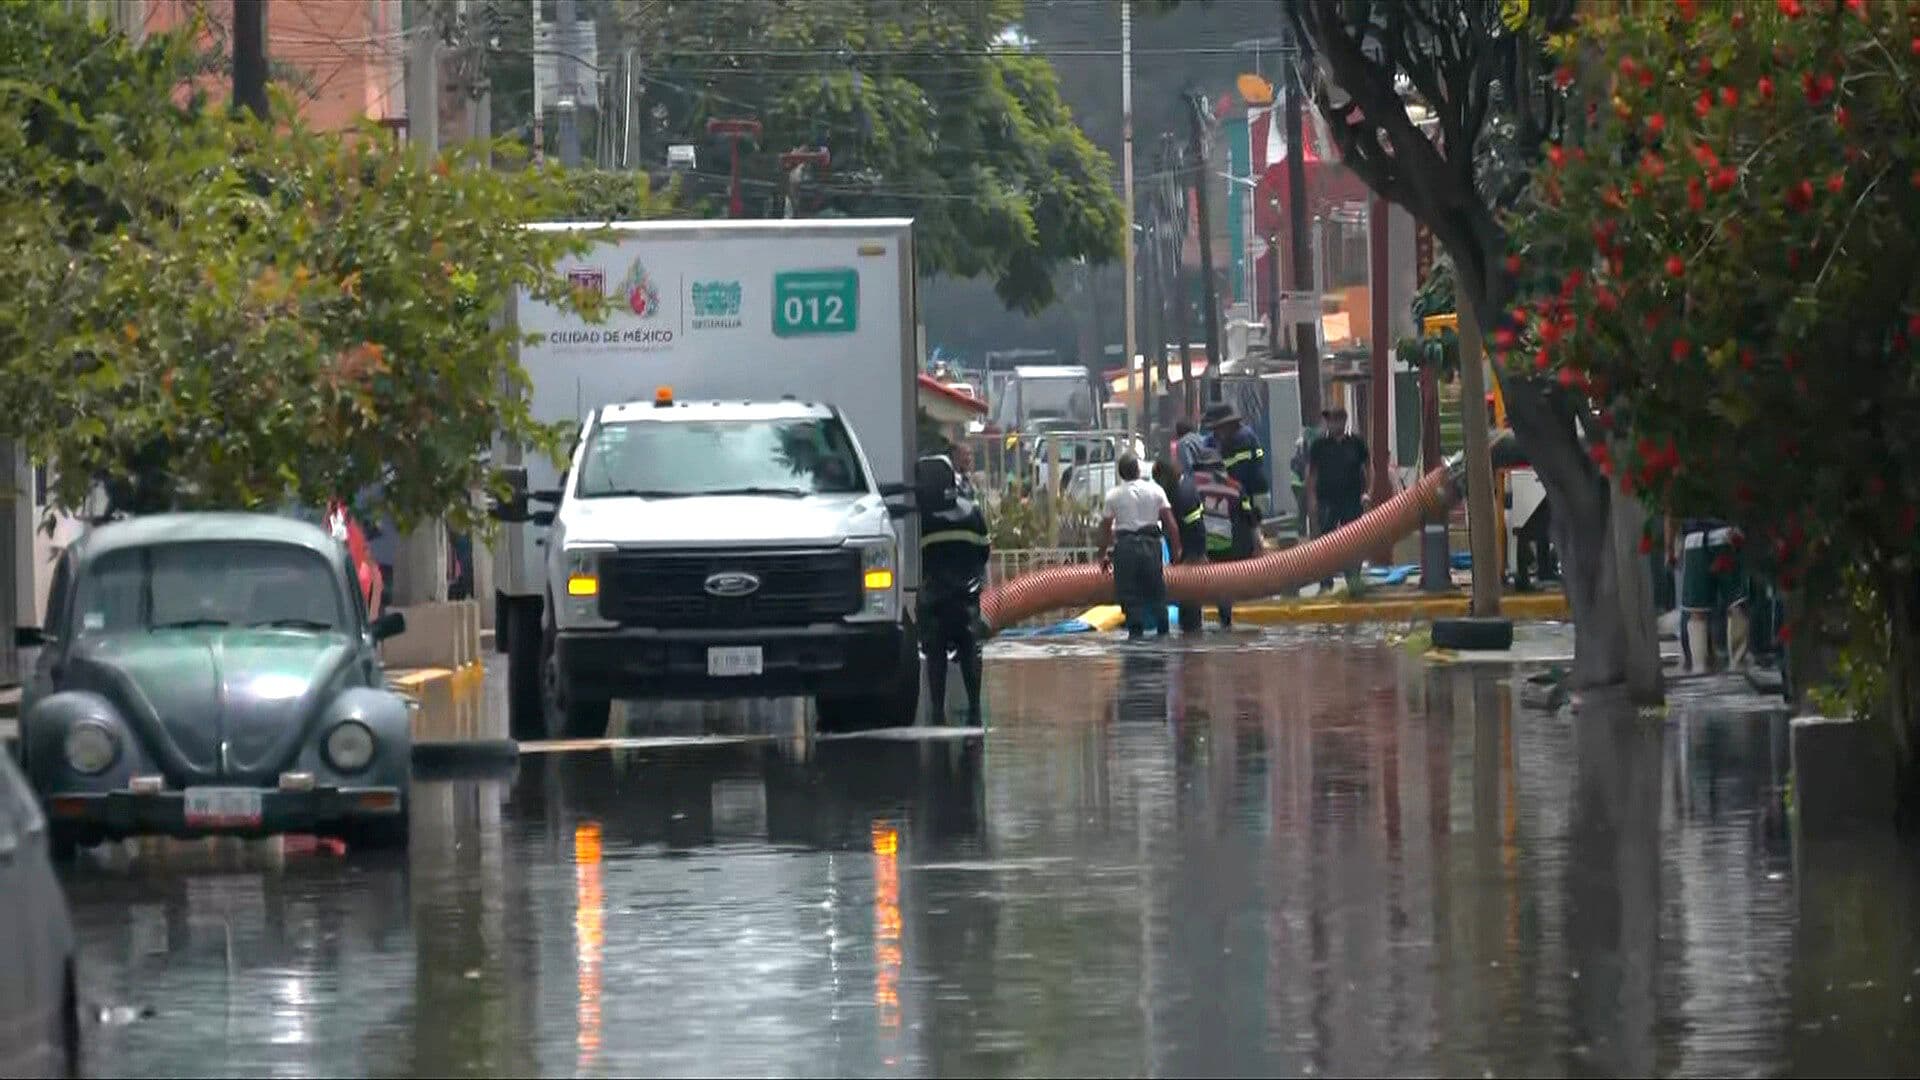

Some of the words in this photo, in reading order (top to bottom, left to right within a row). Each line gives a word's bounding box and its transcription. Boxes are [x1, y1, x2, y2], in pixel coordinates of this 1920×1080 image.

[784, 296, 845, 325] 012
[550, 331, 599, 343] CIUDAD
[603, 331, 619, 342] DE
[623, 328, 673, 342] MÉXICO
